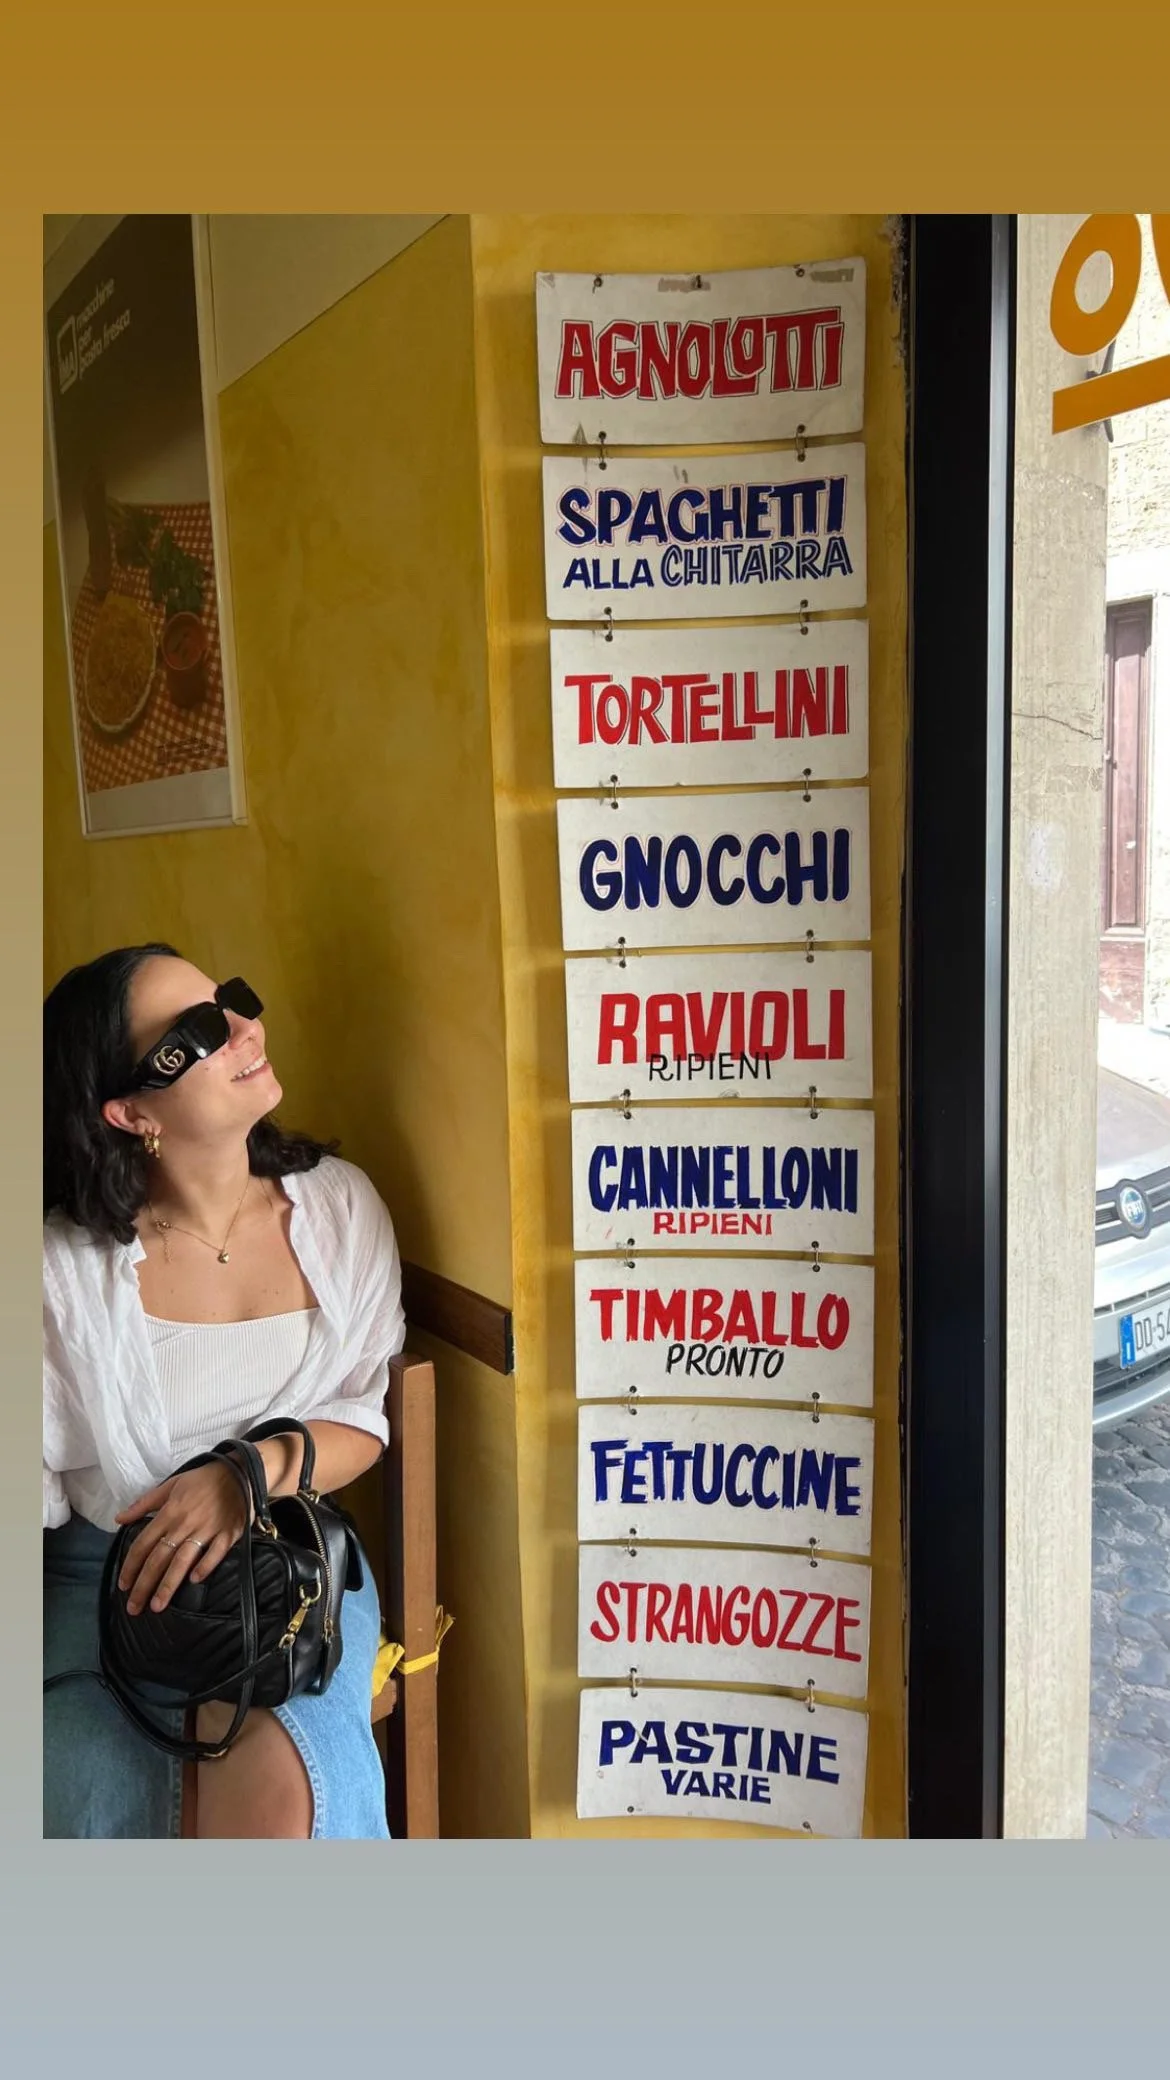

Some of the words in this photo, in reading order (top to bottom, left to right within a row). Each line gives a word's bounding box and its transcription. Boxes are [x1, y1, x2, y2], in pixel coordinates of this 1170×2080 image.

[554, 306, 844, 400] AGNOLOTTI
[556, 475, 848, 546] SPAGHETTI
[563, 558, 654, 589] ALLA
[661, 536, 853, 587] CHITARRA
[564, 664, 849, 745] TORTELLINI
[579, 828, 850, 911] GNOCCHI
[598, 989, 845, 1064] RAVIOLI
[649, 1052, 771, 1081] RIPIENI
[588, 1145, 858, 1213] CANNELLONI
[653, 1212, 772, 1235] RIPIENI
[590, 1288, 850, 1350] TIMBALLO
[665, 1343, 784, 1378] PRONTO
[590, 1440, 861, 1515] FETTUCCINE
[590, 1581, 862, 1662] STRANGOZZE
[599, 1720, 839, 1784] PASTINE
[661, 1769, 771, 1804] VARIE
